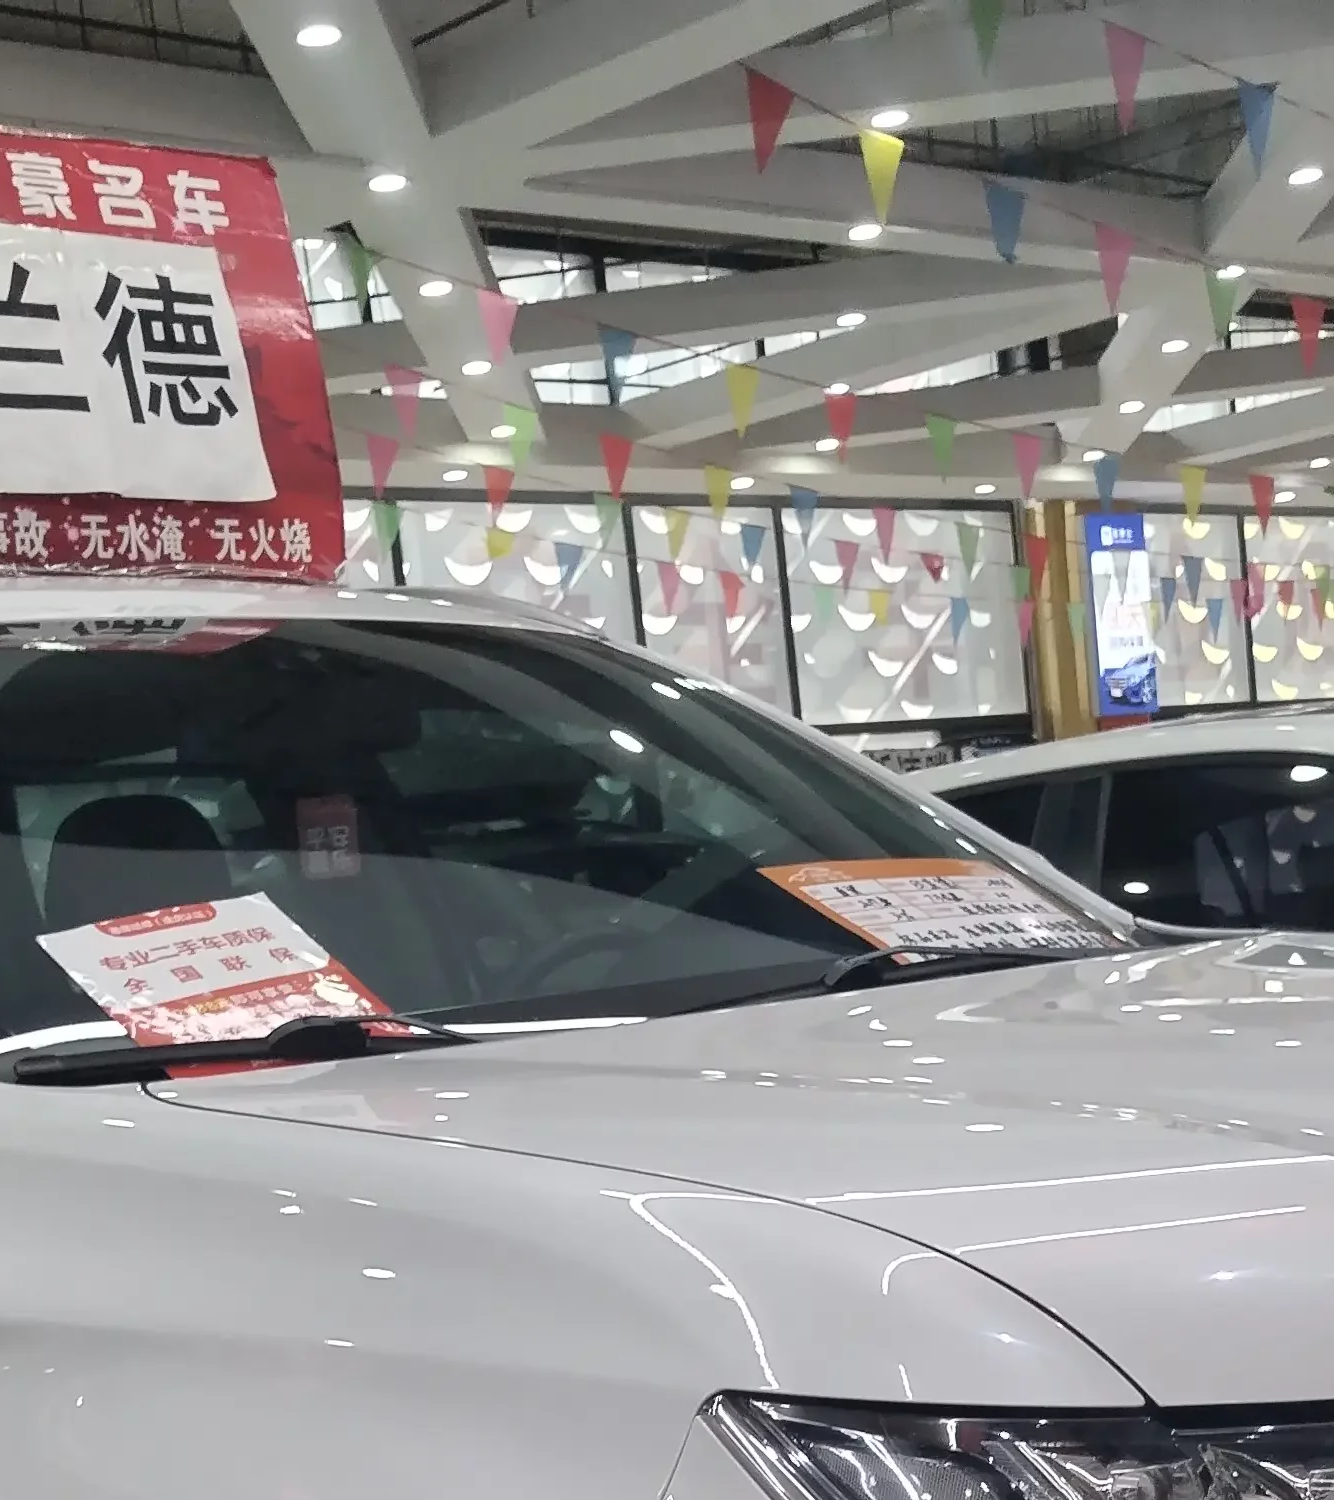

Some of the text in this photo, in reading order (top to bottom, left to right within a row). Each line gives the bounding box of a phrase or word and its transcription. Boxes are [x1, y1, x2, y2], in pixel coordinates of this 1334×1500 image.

[80, 513, 187, 563] 无水淹
[210, 516, 314, 565] 无火烧
[99, 926, 276, 972] 专业二手车质保
[123, 947, 299, 996] 全国联保
